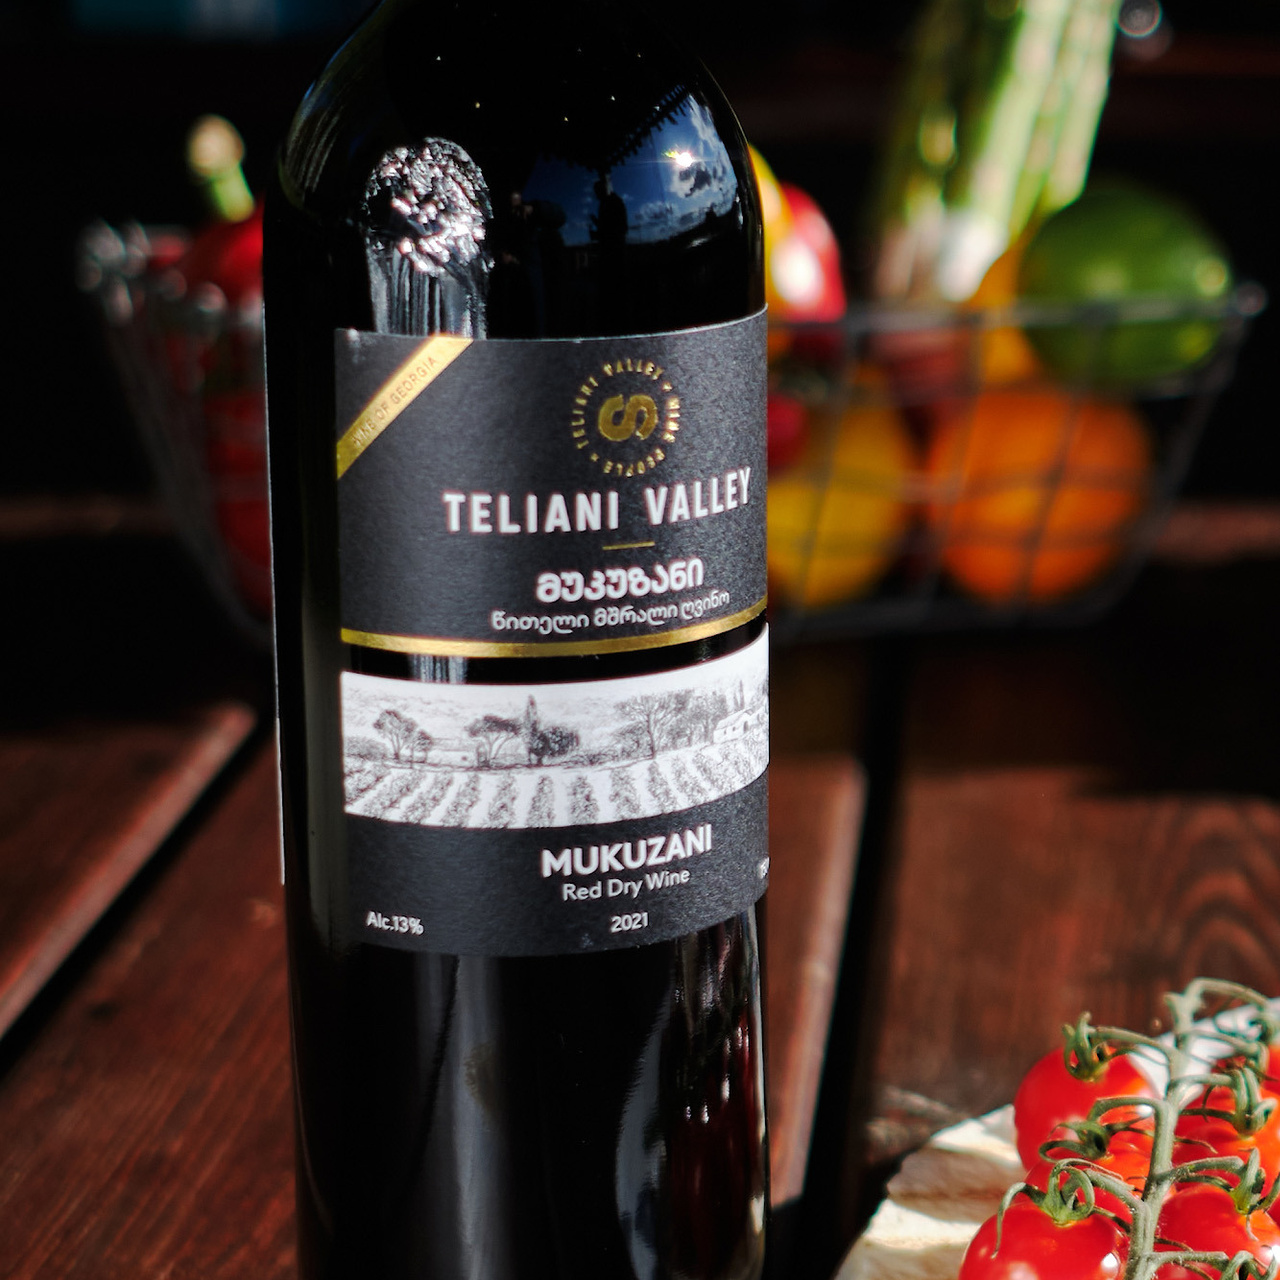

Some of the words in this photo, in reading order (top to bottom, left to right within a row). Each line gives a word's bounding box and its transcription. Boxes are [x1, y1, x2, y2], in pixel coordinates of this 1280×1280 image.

[375, 402, 390, 420] OF
[390, 356, 436, 405] GEORGIA
[443, 490, 619, 533] TELIANI
[644, 466, 751, 526] VALLEY
[537, 558, 704, 603] მუკუზანი
[542, 823, 712, 878] MUKUZANI
[562, 880, 602, 901] Red
[607, 878, 643, 899] Dry
[645, 869, 691, 891] Wine
[366, 910, 424, 936] Alc.13%
[610, 911, 649, 934] 2021
